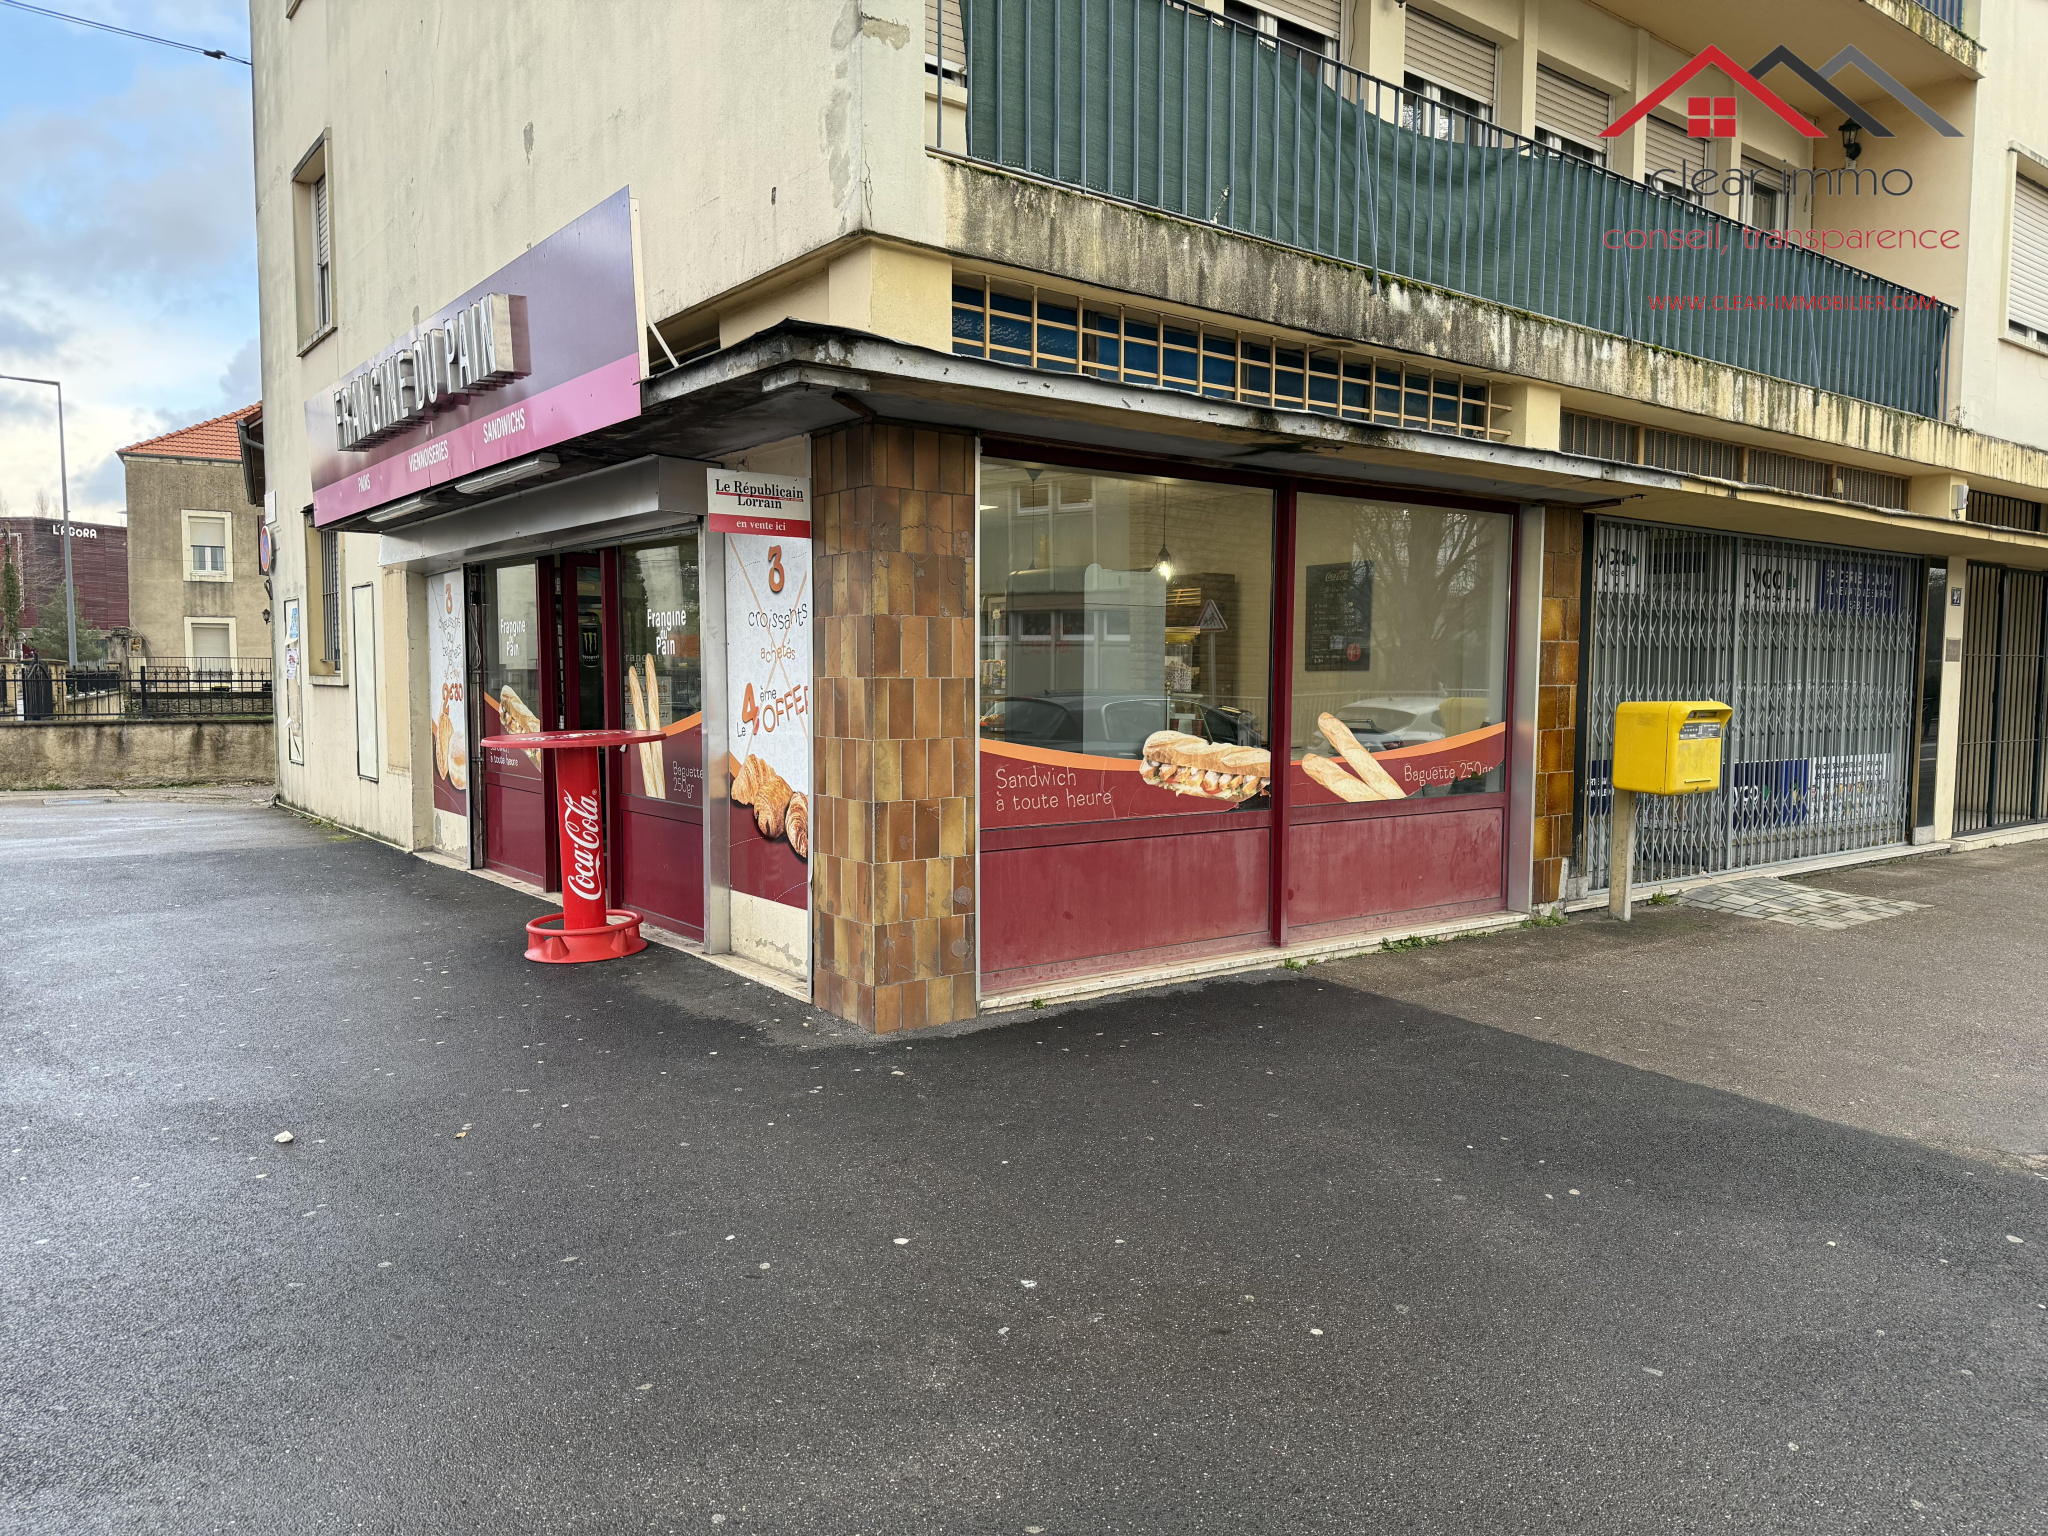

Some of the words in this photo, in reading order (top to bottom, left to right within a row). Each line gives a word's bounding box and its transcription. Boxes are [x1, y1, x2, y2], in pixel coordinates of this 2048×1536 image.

[334, 349, 412, 451] FRANGINE
[412, 328, 441, 411] DU
[443, 292, 506, 395] PAIN
[483, 407, 526, 443] SANDWICHS
[715, 479, 730, 492] Le
[734, 480, 804, 499] Républicain
[737, 494, 782, 509] Lorrain
[736, 520, 747, 528] en
[750, 521, 774, 530] vente
[775, 521, 786, 531] ici
[768, 545, 785, 593] 3
[500, 619, 526, 637] Frangine
[647, 609, 687, 631] Frangine
[748, 604, 808, 630] croissants
[660, 627, 668, 639] du
[506, 641, 520, 657] Pain
[656, 637, 675, 655] Pain
[760, 638, 796, 663] achetés
[736, 722, 747, 738] Le
[742, 683, 760, 735] 4
[760, 687, 777, 702] ème
[673, 761, 703, 779] Baguette
[996, 765, 1077, 789] Sandwich
[1404, 765, 1456, 786] Baguette
[673, 777, 694, 799] 250gr
[996, 791, 1005, 811] à
[1013, 794, 1059, 811] toute
[1066, 788, 1112, 808] heure
